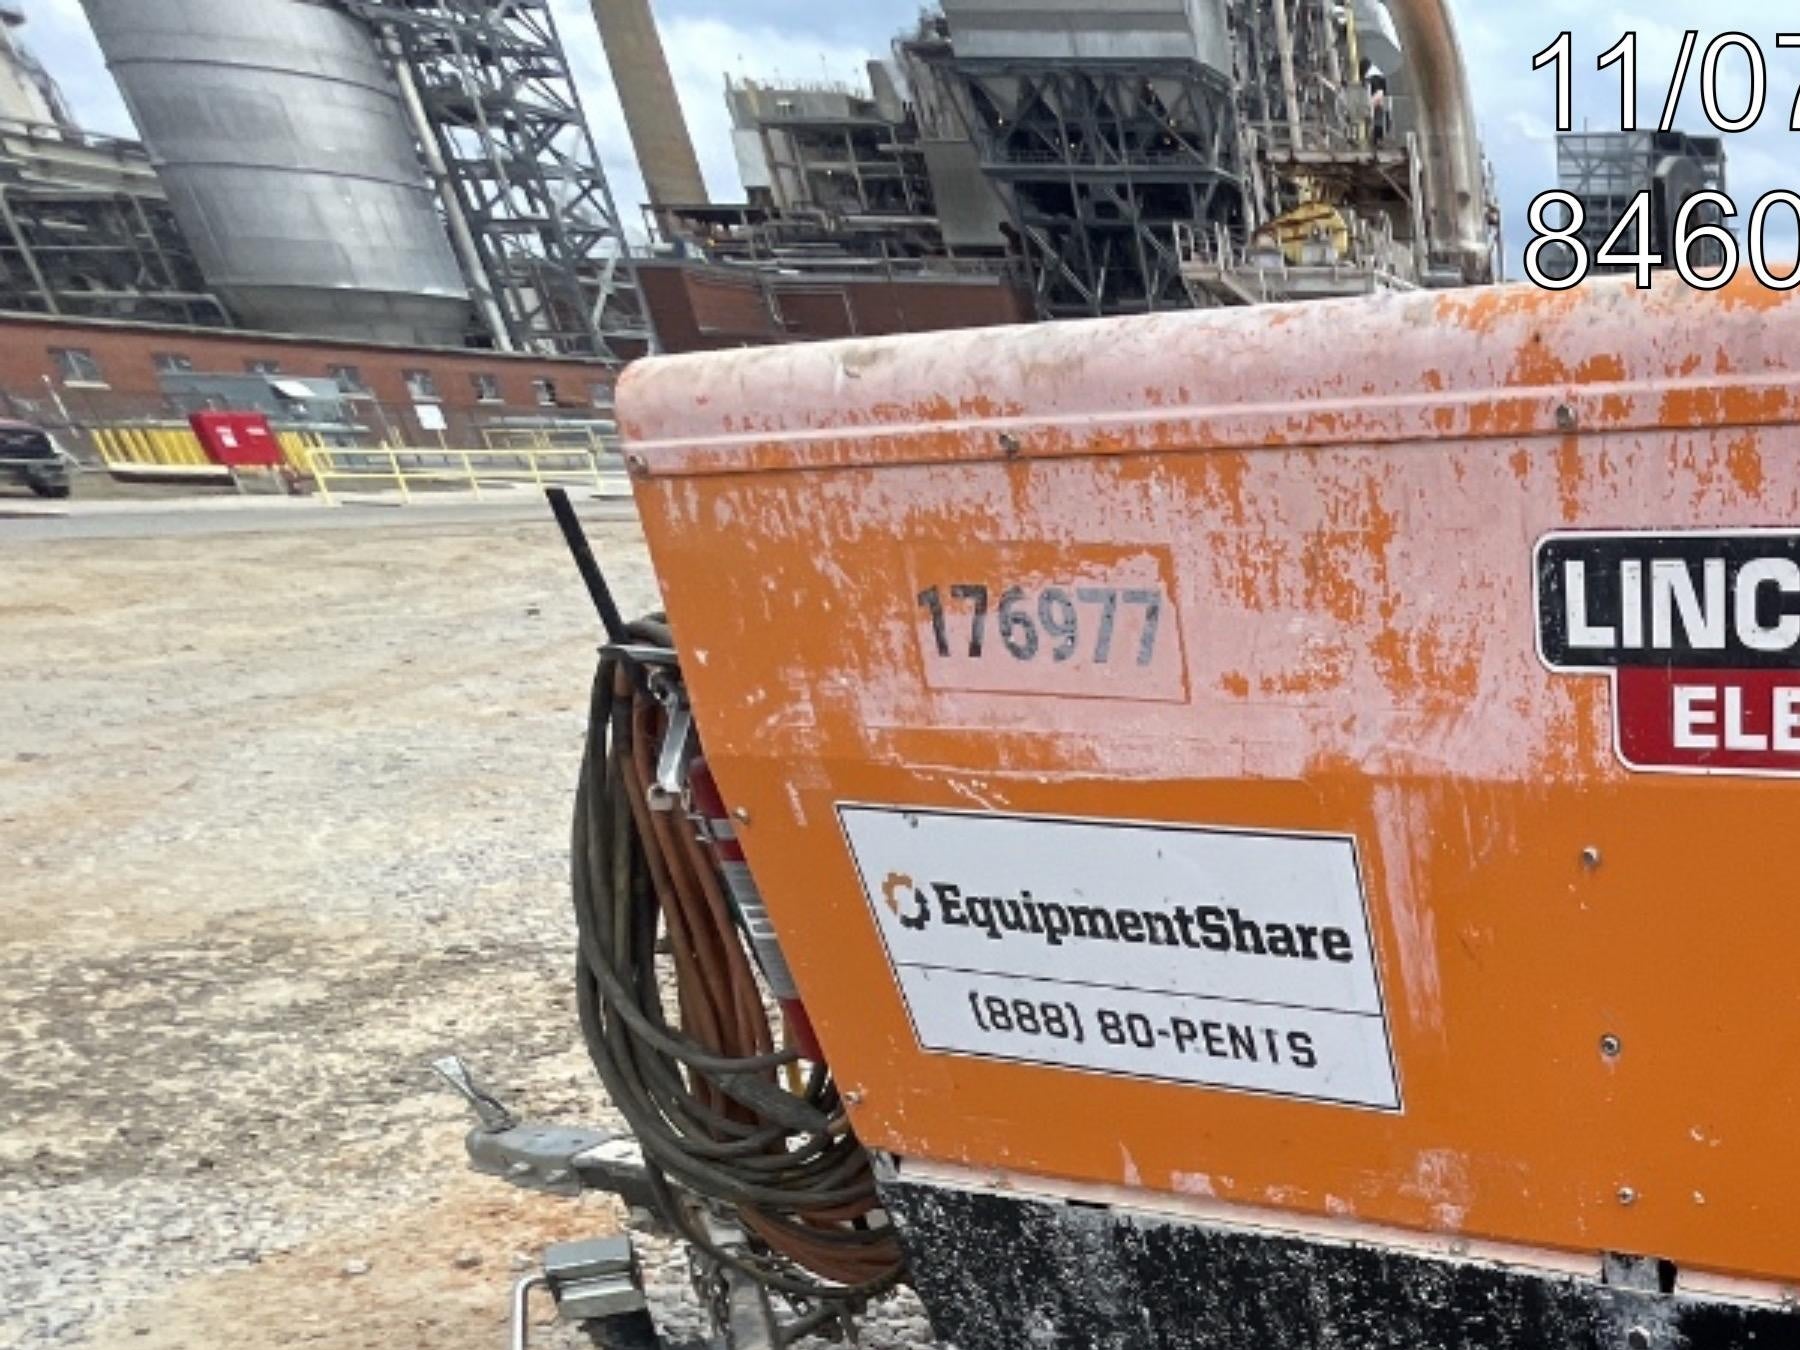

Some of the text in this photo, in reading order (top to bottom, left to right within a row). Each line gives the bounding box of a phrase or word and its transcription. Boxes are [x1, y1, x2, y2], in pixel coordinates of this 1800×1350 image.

[918, 583, 1162, 666] 176977
[930, 881, 1354, 965] EquipmentShare
[967, 990, 1085, 1043] (888)
